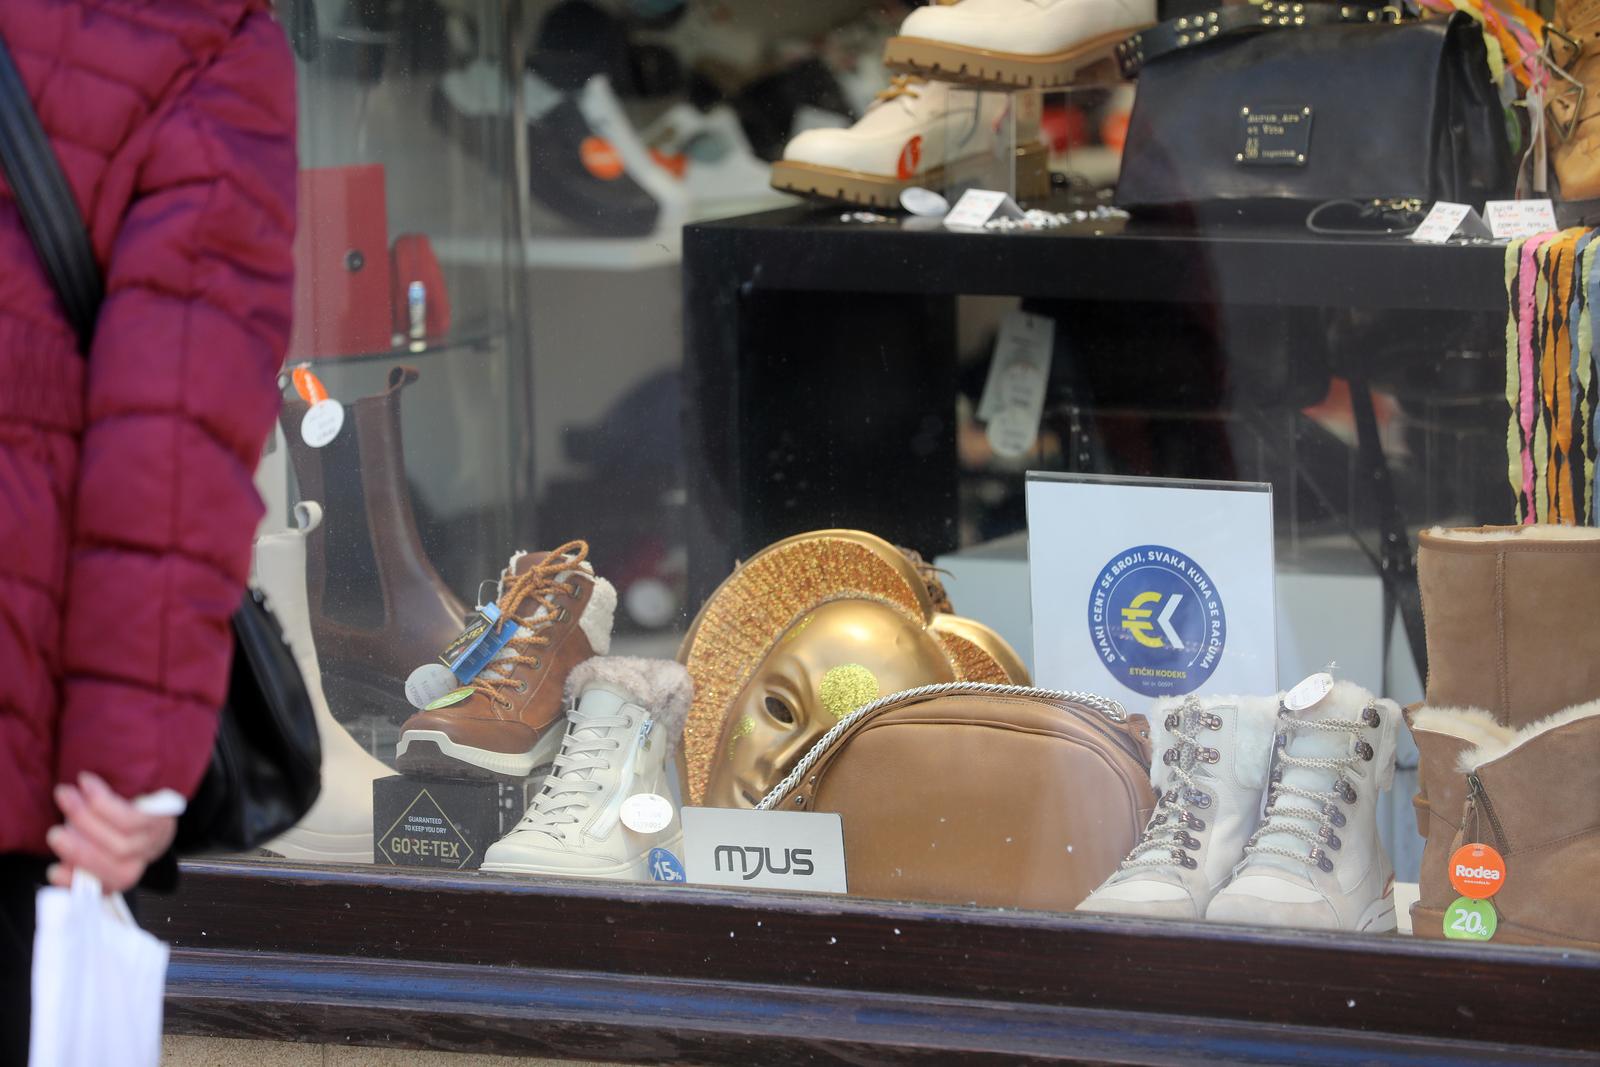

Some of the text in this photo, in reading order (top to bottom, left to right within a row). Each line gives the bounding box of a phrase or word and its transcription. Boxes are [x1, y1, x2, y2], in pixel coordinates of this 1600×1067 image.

[1094, 551, 1222, 670] SVAKI CENT SE BROJI, SVAKA KUNA SE RAČUNA
[1129, 666, 1187, 679] ETIČKI KODEKS
[408, 815, 442, 825] GUARANTEED
[411, 825, 425, 833] KEEP
[436, 826, 447, 834] DRY
[391, 837, 460, 858] GORE-TEX
[1456, 864, 1500, 880] Rodea
[1450, 908, 1488, 936] 20%
